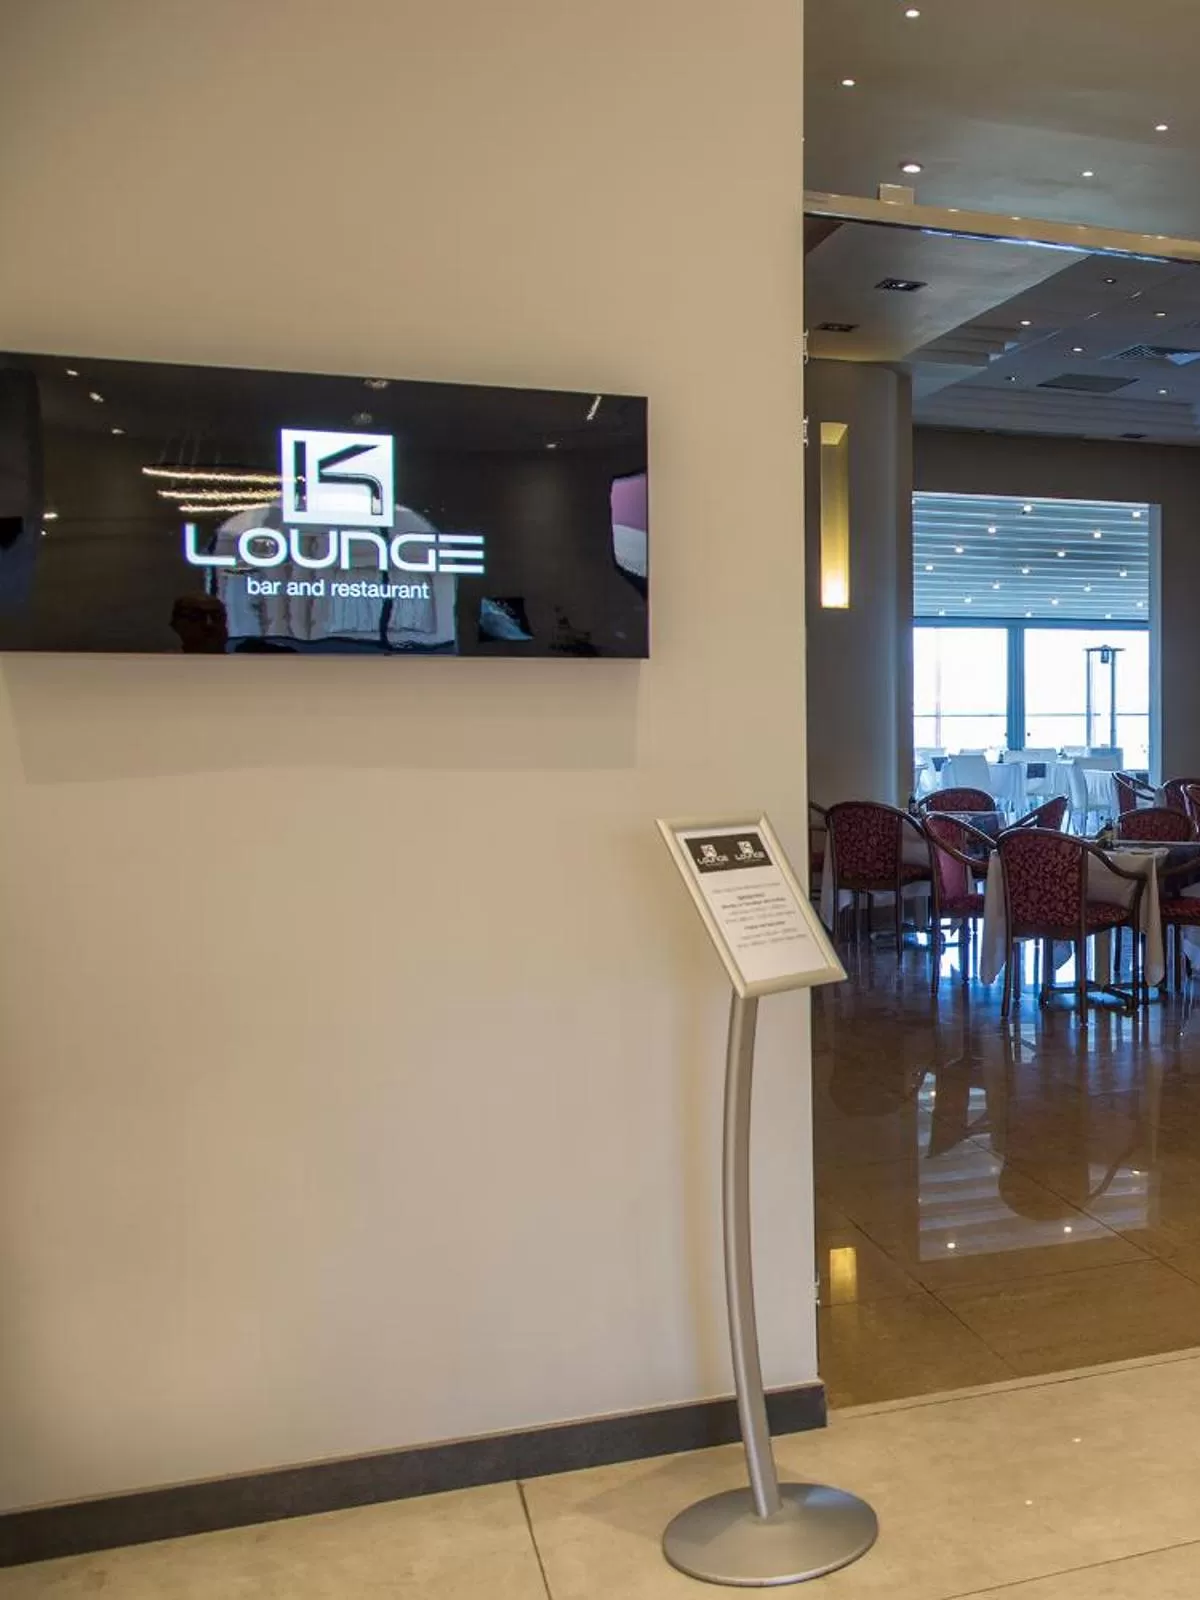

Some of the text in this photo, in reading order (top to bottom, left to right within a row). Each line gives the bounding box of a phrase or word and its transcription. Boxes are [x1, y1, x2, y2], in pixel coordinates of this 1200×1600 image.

[184, 523, 485, 574] LOUNGE
[247, 577, 431, 600] bar and restaurant
